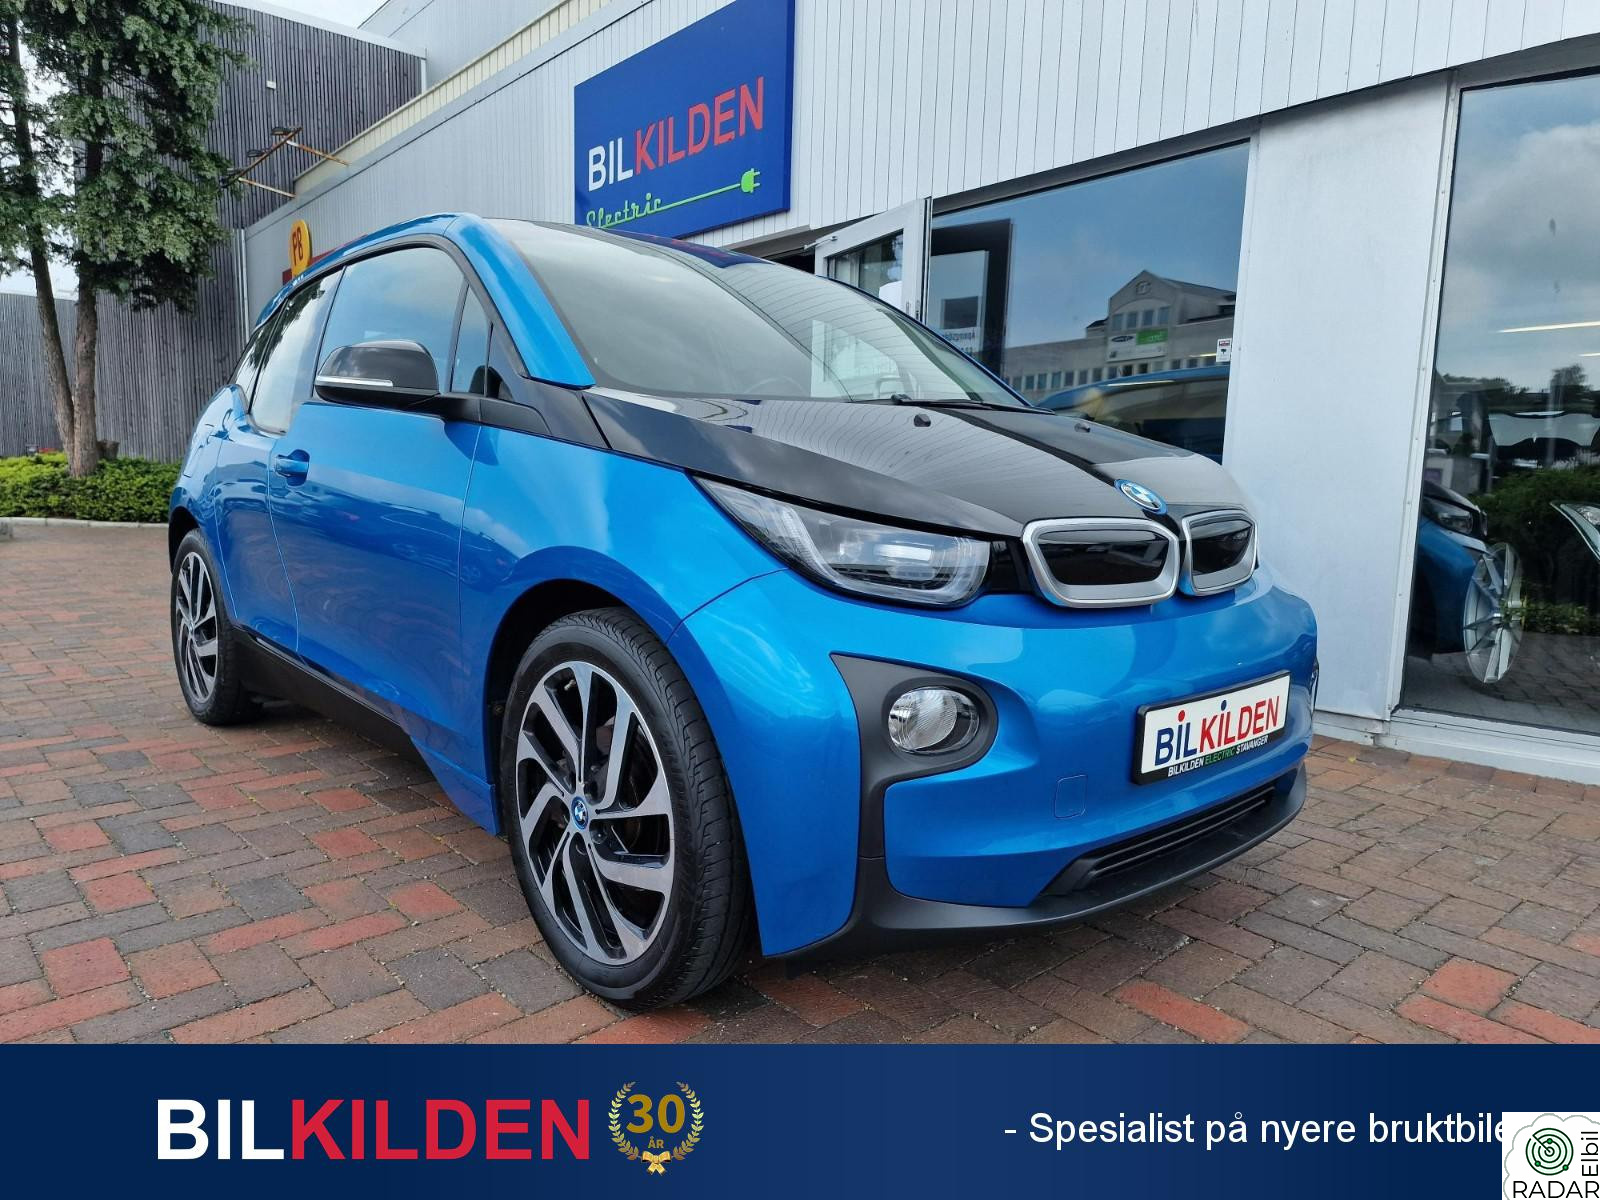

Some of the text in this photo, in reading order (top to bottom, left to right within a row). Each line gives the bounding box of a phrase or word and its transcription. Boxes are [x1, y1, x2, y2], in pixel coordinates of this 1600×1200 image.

[588, 76, 765, 192] BILKILDEN
[586, 192, 662, 228] Electric
[1168, 735, 1269, 777] BILKILDEN ELECTRIC STAVANGER
